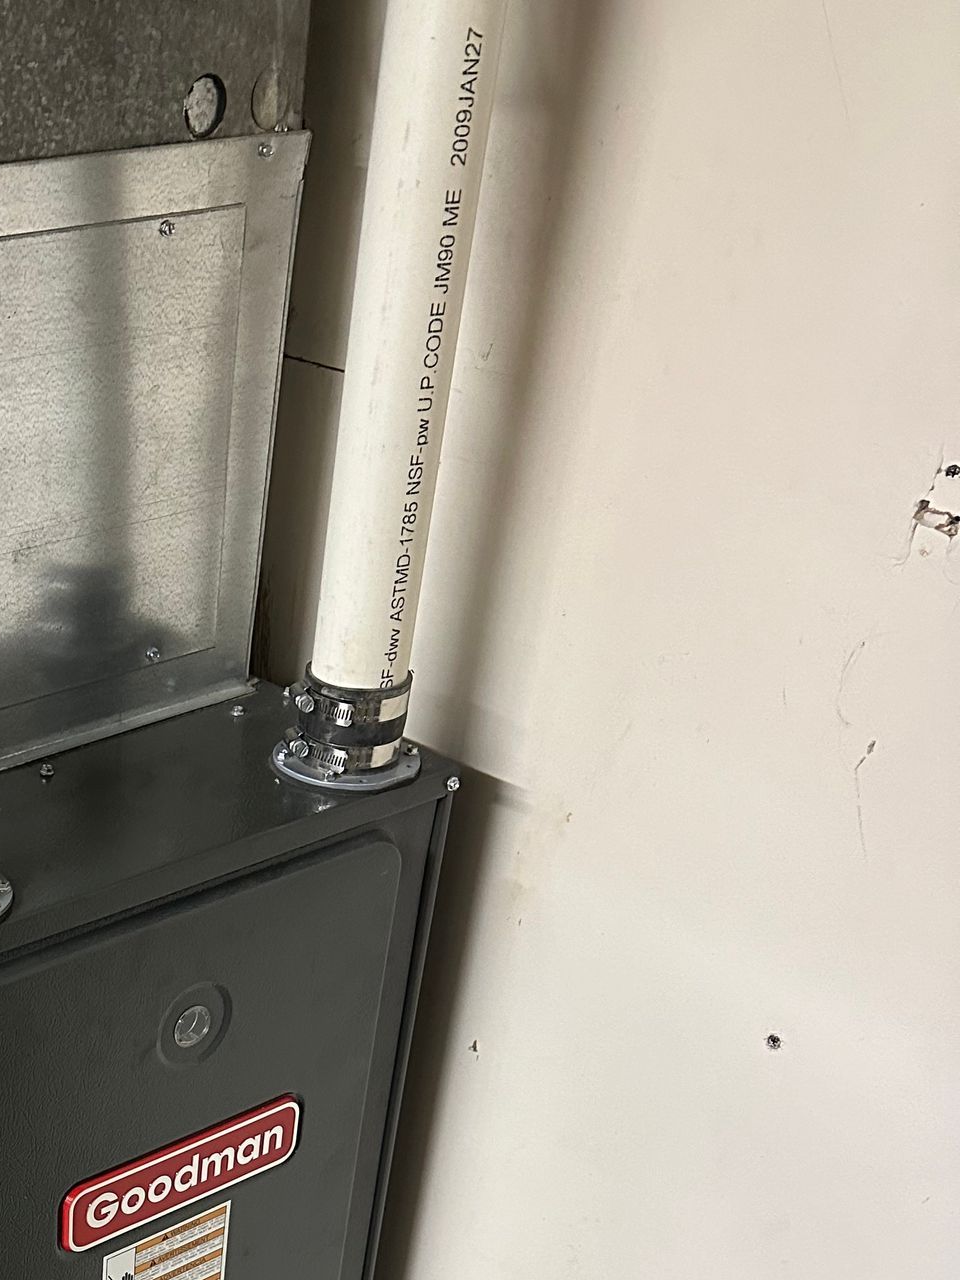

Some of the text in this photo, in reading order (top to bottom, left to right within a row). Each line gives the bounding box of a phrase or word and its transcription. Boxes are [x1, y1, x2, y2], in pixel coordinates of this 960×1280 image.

[450, 27, 484, 167] 2009JAN27
[442, 188, 462, 227] ME
[434, 235, 456, 294] JM90
[406, 416, 429, 497] NSF-pw
[386, 500, 418, 622] ASTMD-1785
[86, 1124, 284, 1229] Goodman
